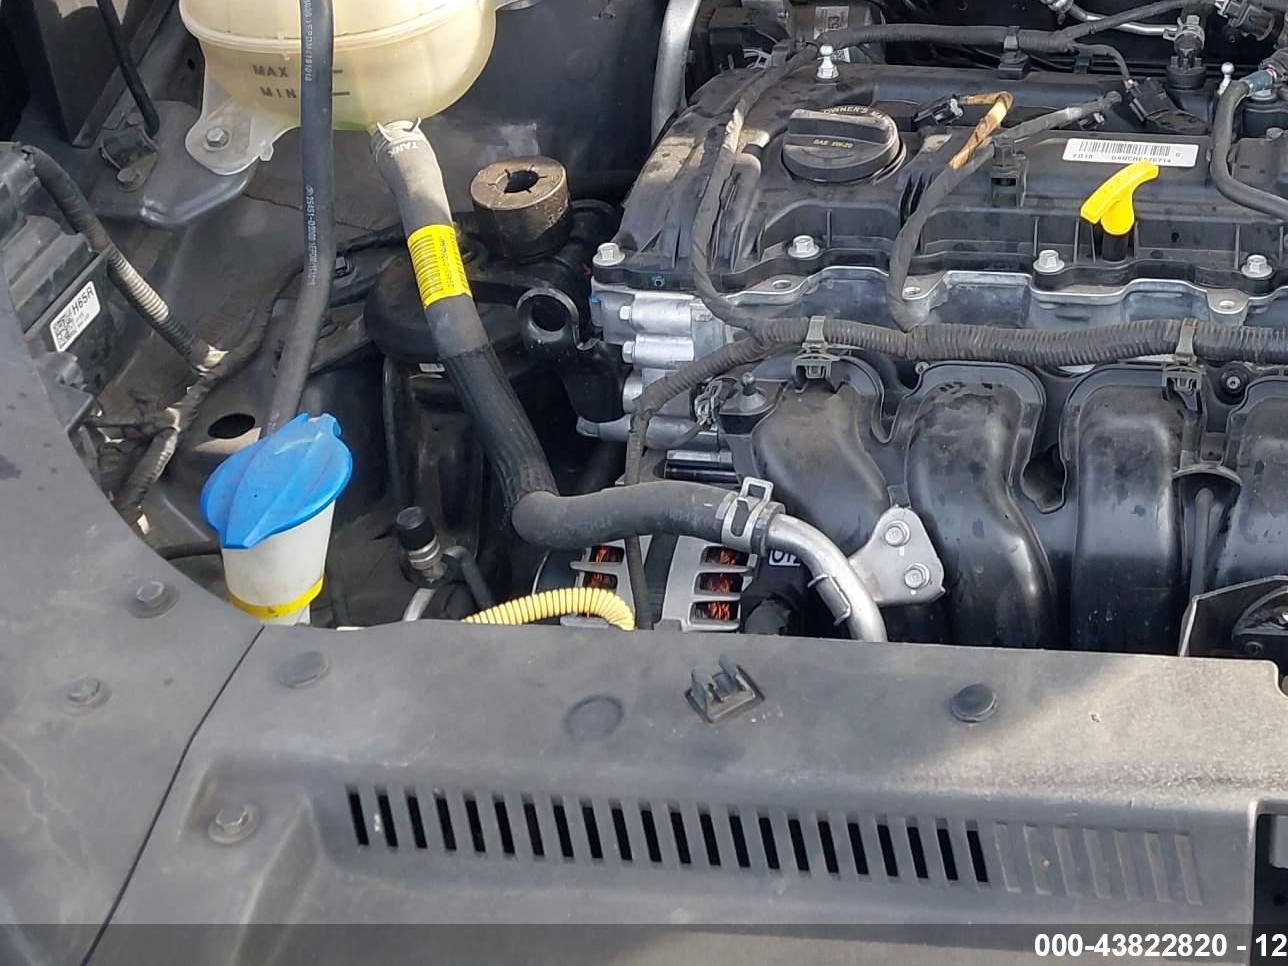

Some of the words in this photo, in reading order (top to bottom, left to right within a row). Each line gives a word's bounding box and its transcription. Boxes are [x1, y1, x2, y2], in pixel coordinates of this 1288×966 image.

[252, 64, 289, 78] MAX
[259, 86, 297, 99] MIN
[823, 106, 868, 115] OWNER'S
[813, 138, 829, 146] SAE
[387, 141, 417, 158] TANK
